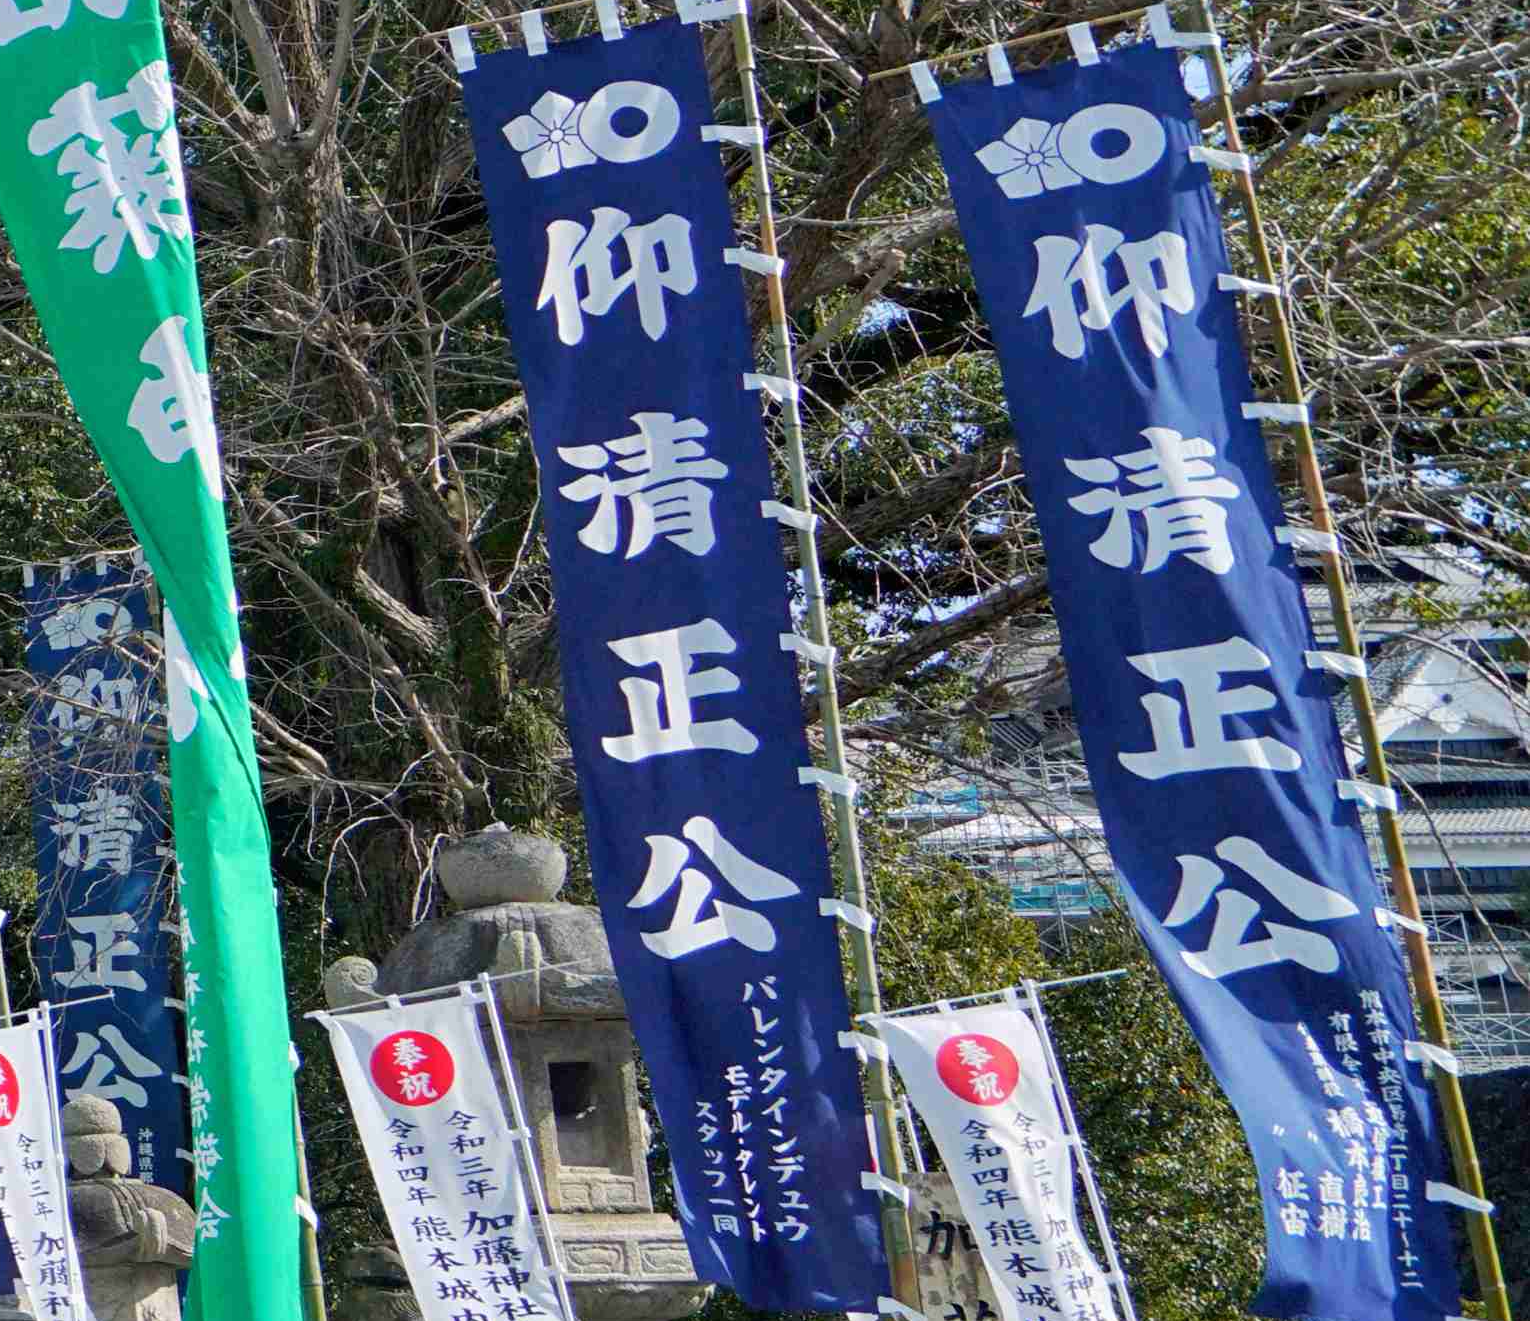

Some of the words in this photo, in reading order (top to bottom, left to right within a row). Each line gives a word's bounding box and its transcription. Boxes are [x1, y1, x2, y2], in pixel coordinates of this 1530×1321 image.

[535, 207, 800, 959] 仰清正公
[1022, 224, 1360, 980] 仰清正公
[51, 668, 162, 1108] 仰清正公
[391, 1037, 439, 1102] 奉祝
[956, 1039, 1007, 1100] 奉祝
[14, 1132, 55, 1221] 令和三年
[383, 1116, 439, 1207] 令和四年
[445, 1108, 500, 1201] 令和三年
[695, 1100, 740, 1237] スタッフ一同
[959, 1118, 1020, 1211] 令和四年
[1011, 1109, 1057, 1201] 令和三年
